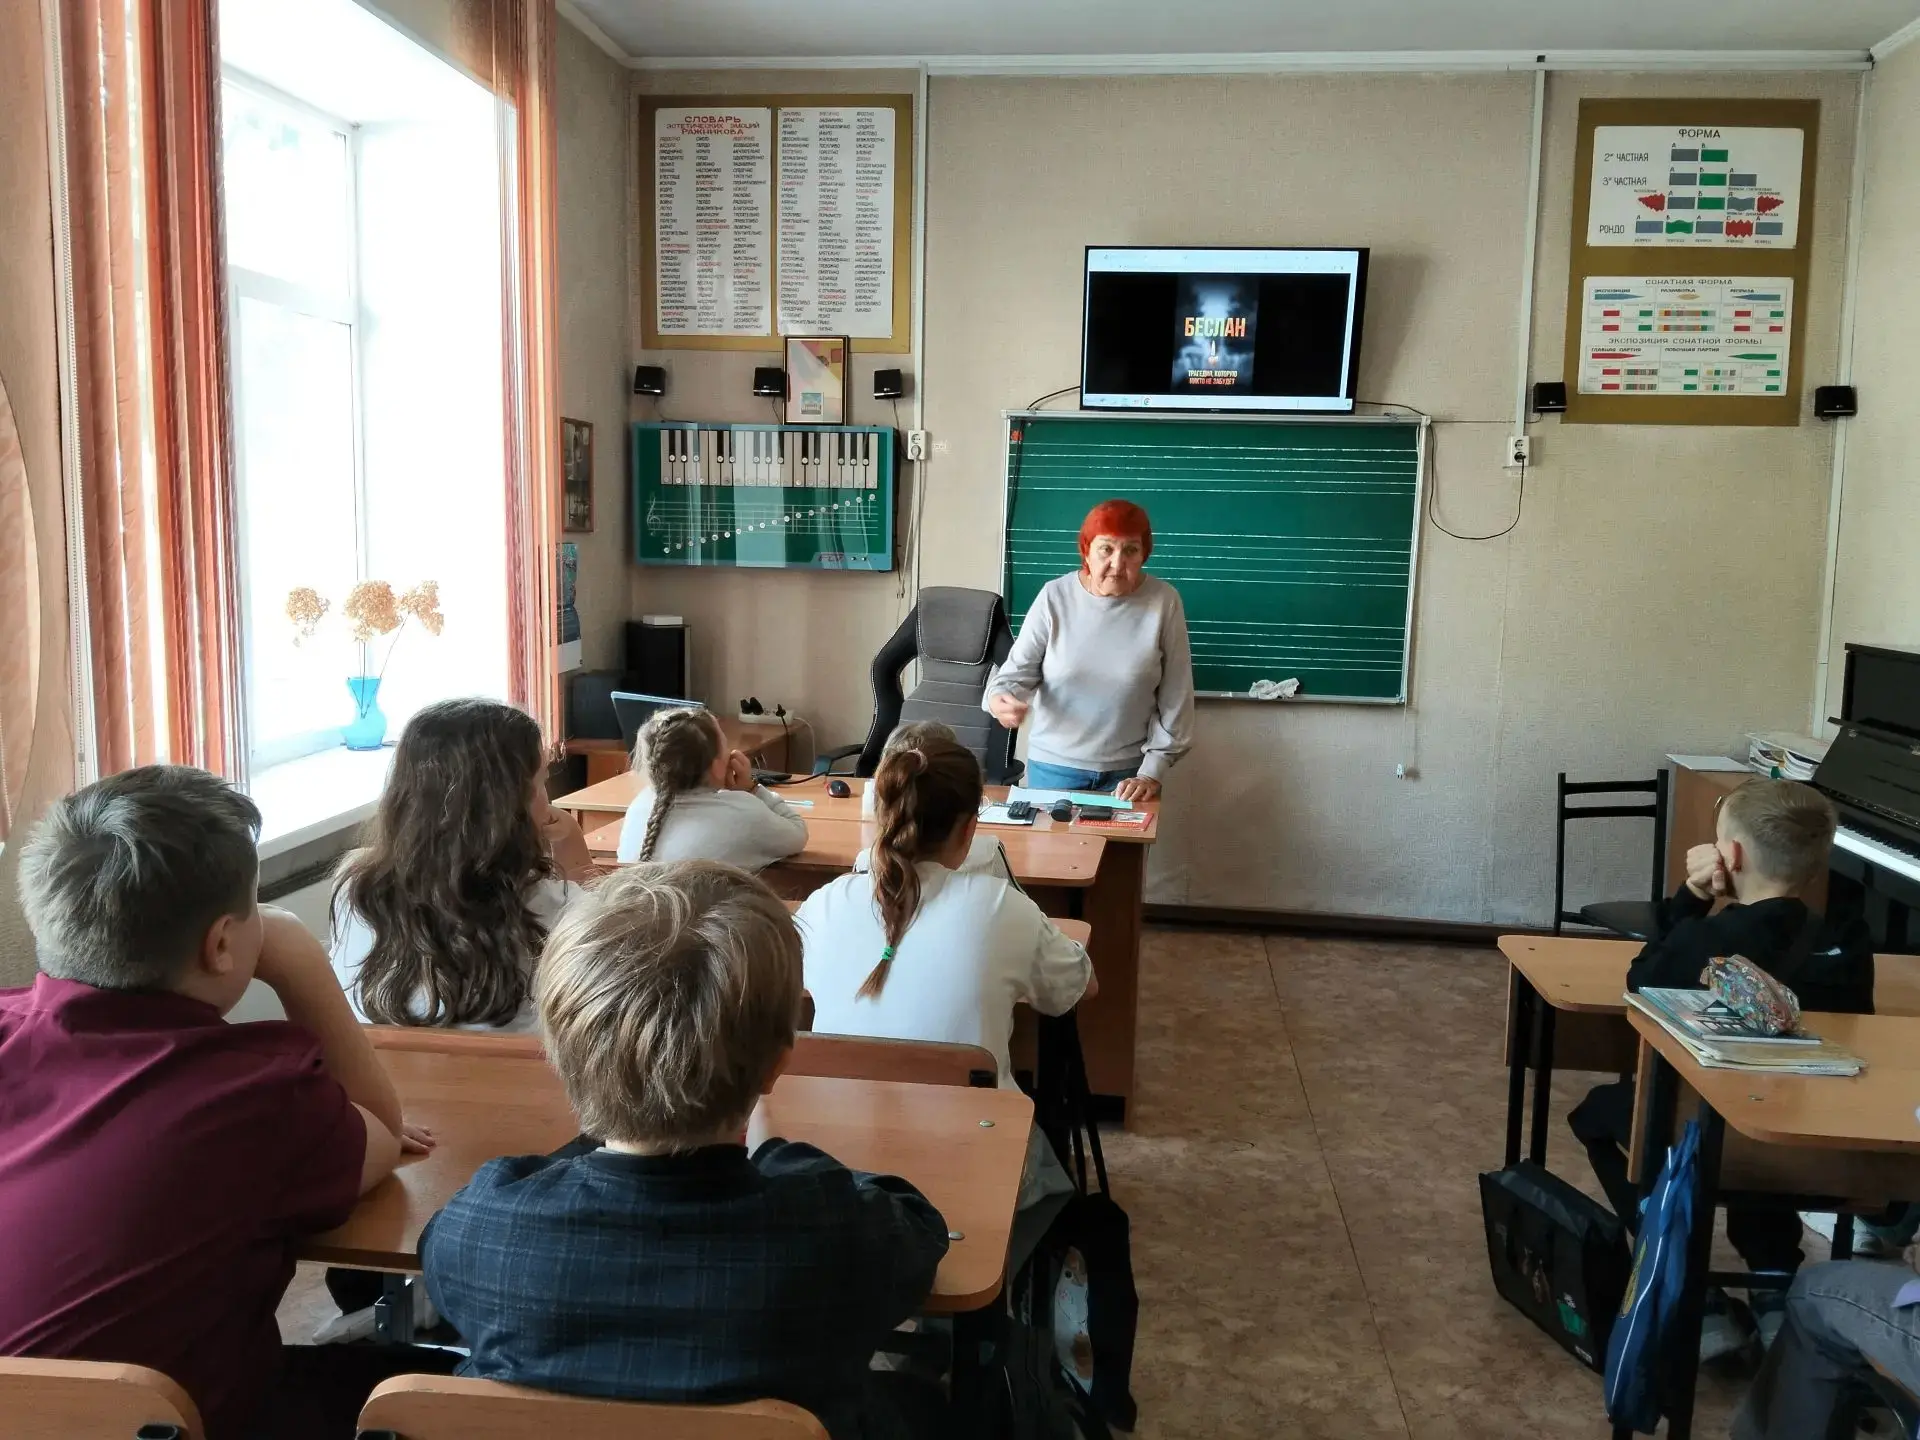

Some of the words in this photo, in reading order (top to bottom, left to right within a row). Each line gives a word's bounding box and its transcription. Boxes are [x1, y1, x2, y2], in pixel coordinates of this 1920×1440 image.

[730, 121, 760, 129] ЭМОЦИЙ
[1678, 128, 1721, 138] ФОРМА
[1616, 152, 1649, 162] ЧАСТНАЯ
[1614, 176, 1647, 186] ЧАСТНАЯ
[1599, 224, 1625, 234] РОНДО
[1184, 317, 1246, 337] БЕСЛАН
[1188, 370, 1213, 378] ТРАГЕДИЯ,
